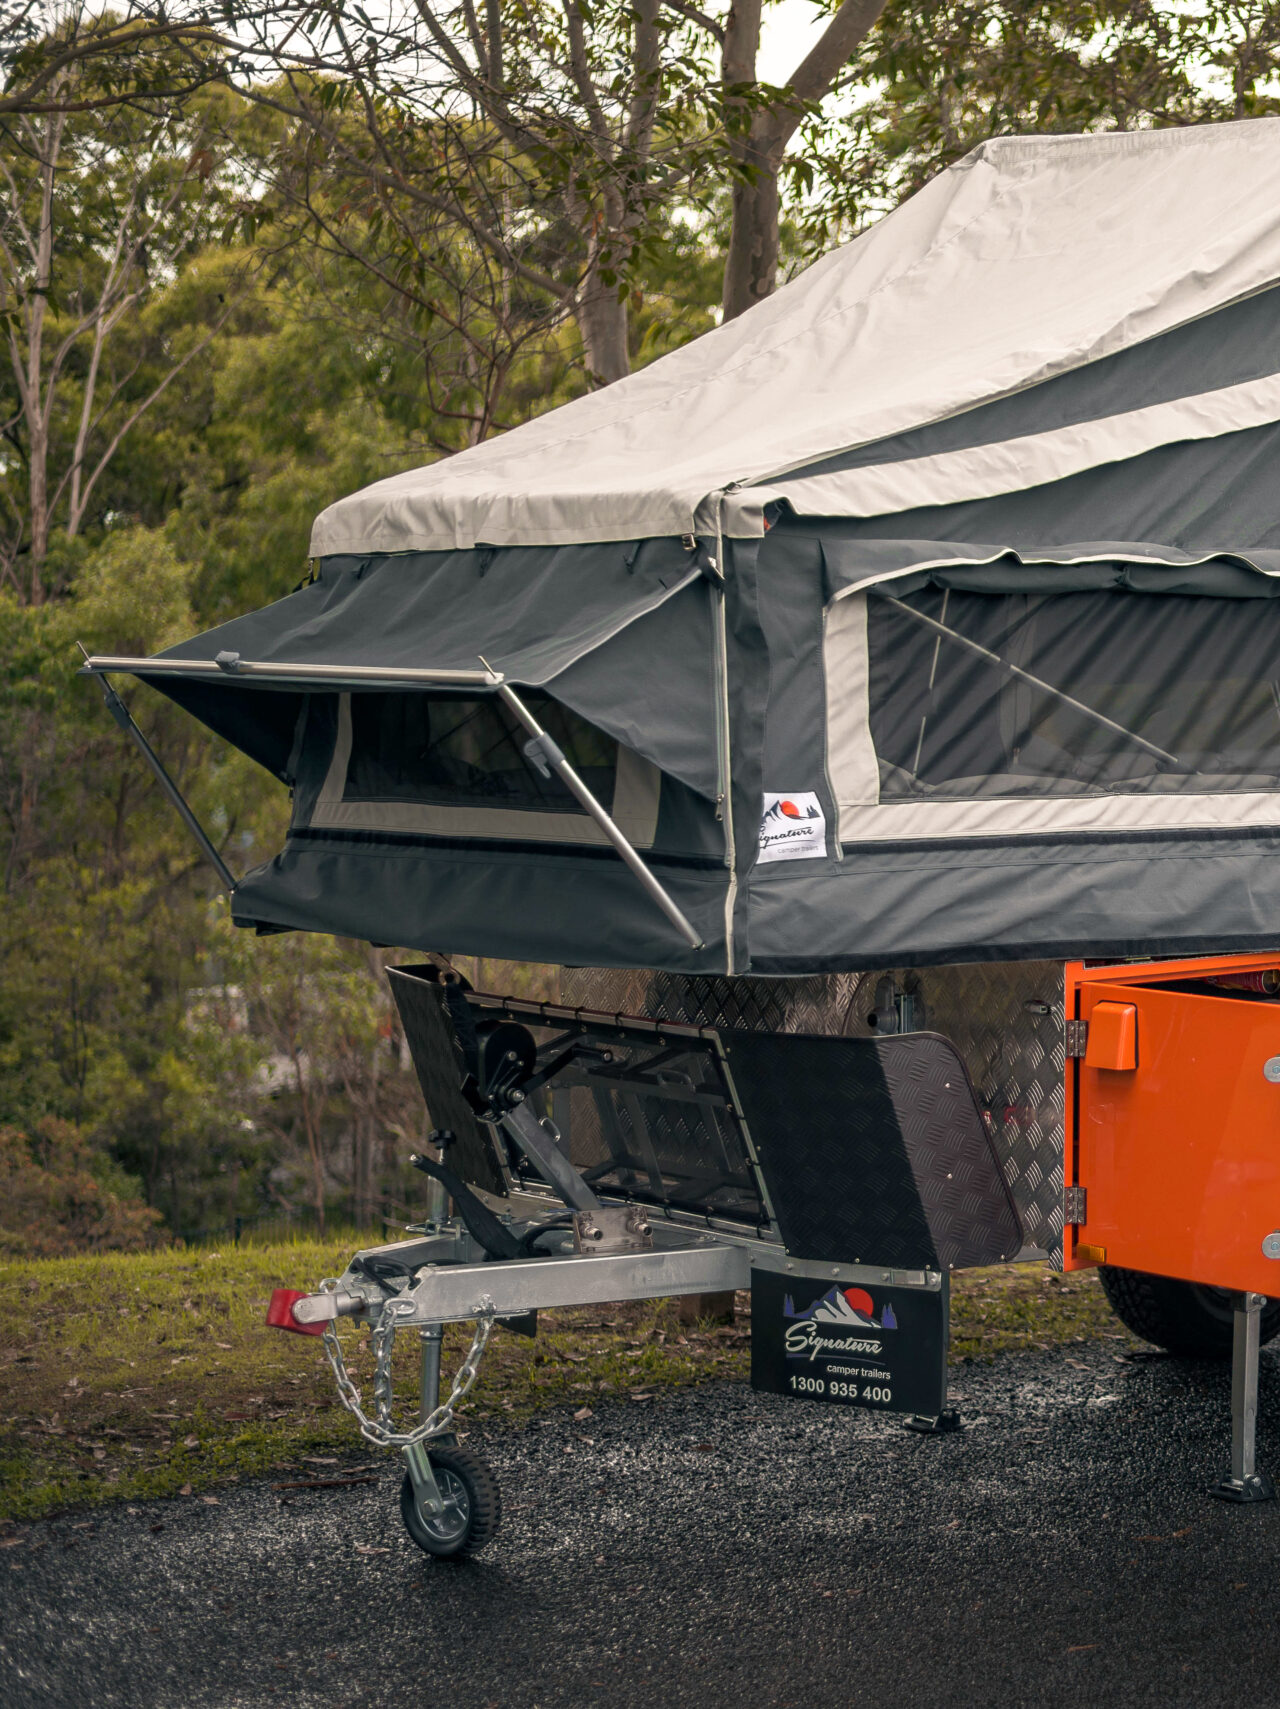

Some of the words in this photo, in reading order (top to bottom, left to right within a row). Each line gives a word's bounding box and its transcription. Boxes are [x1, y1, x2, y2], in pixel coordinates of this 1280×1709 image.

[785, 1321, 882, 1361] Signature
[827, 1364, 859, 1376] camper
[861, 1367, 891, 1380] trailers
[790, 1375, 825, 1394] 1300
[829, 1381, 858, 1398] 935
[862, 1385, 892, 1403] 400
